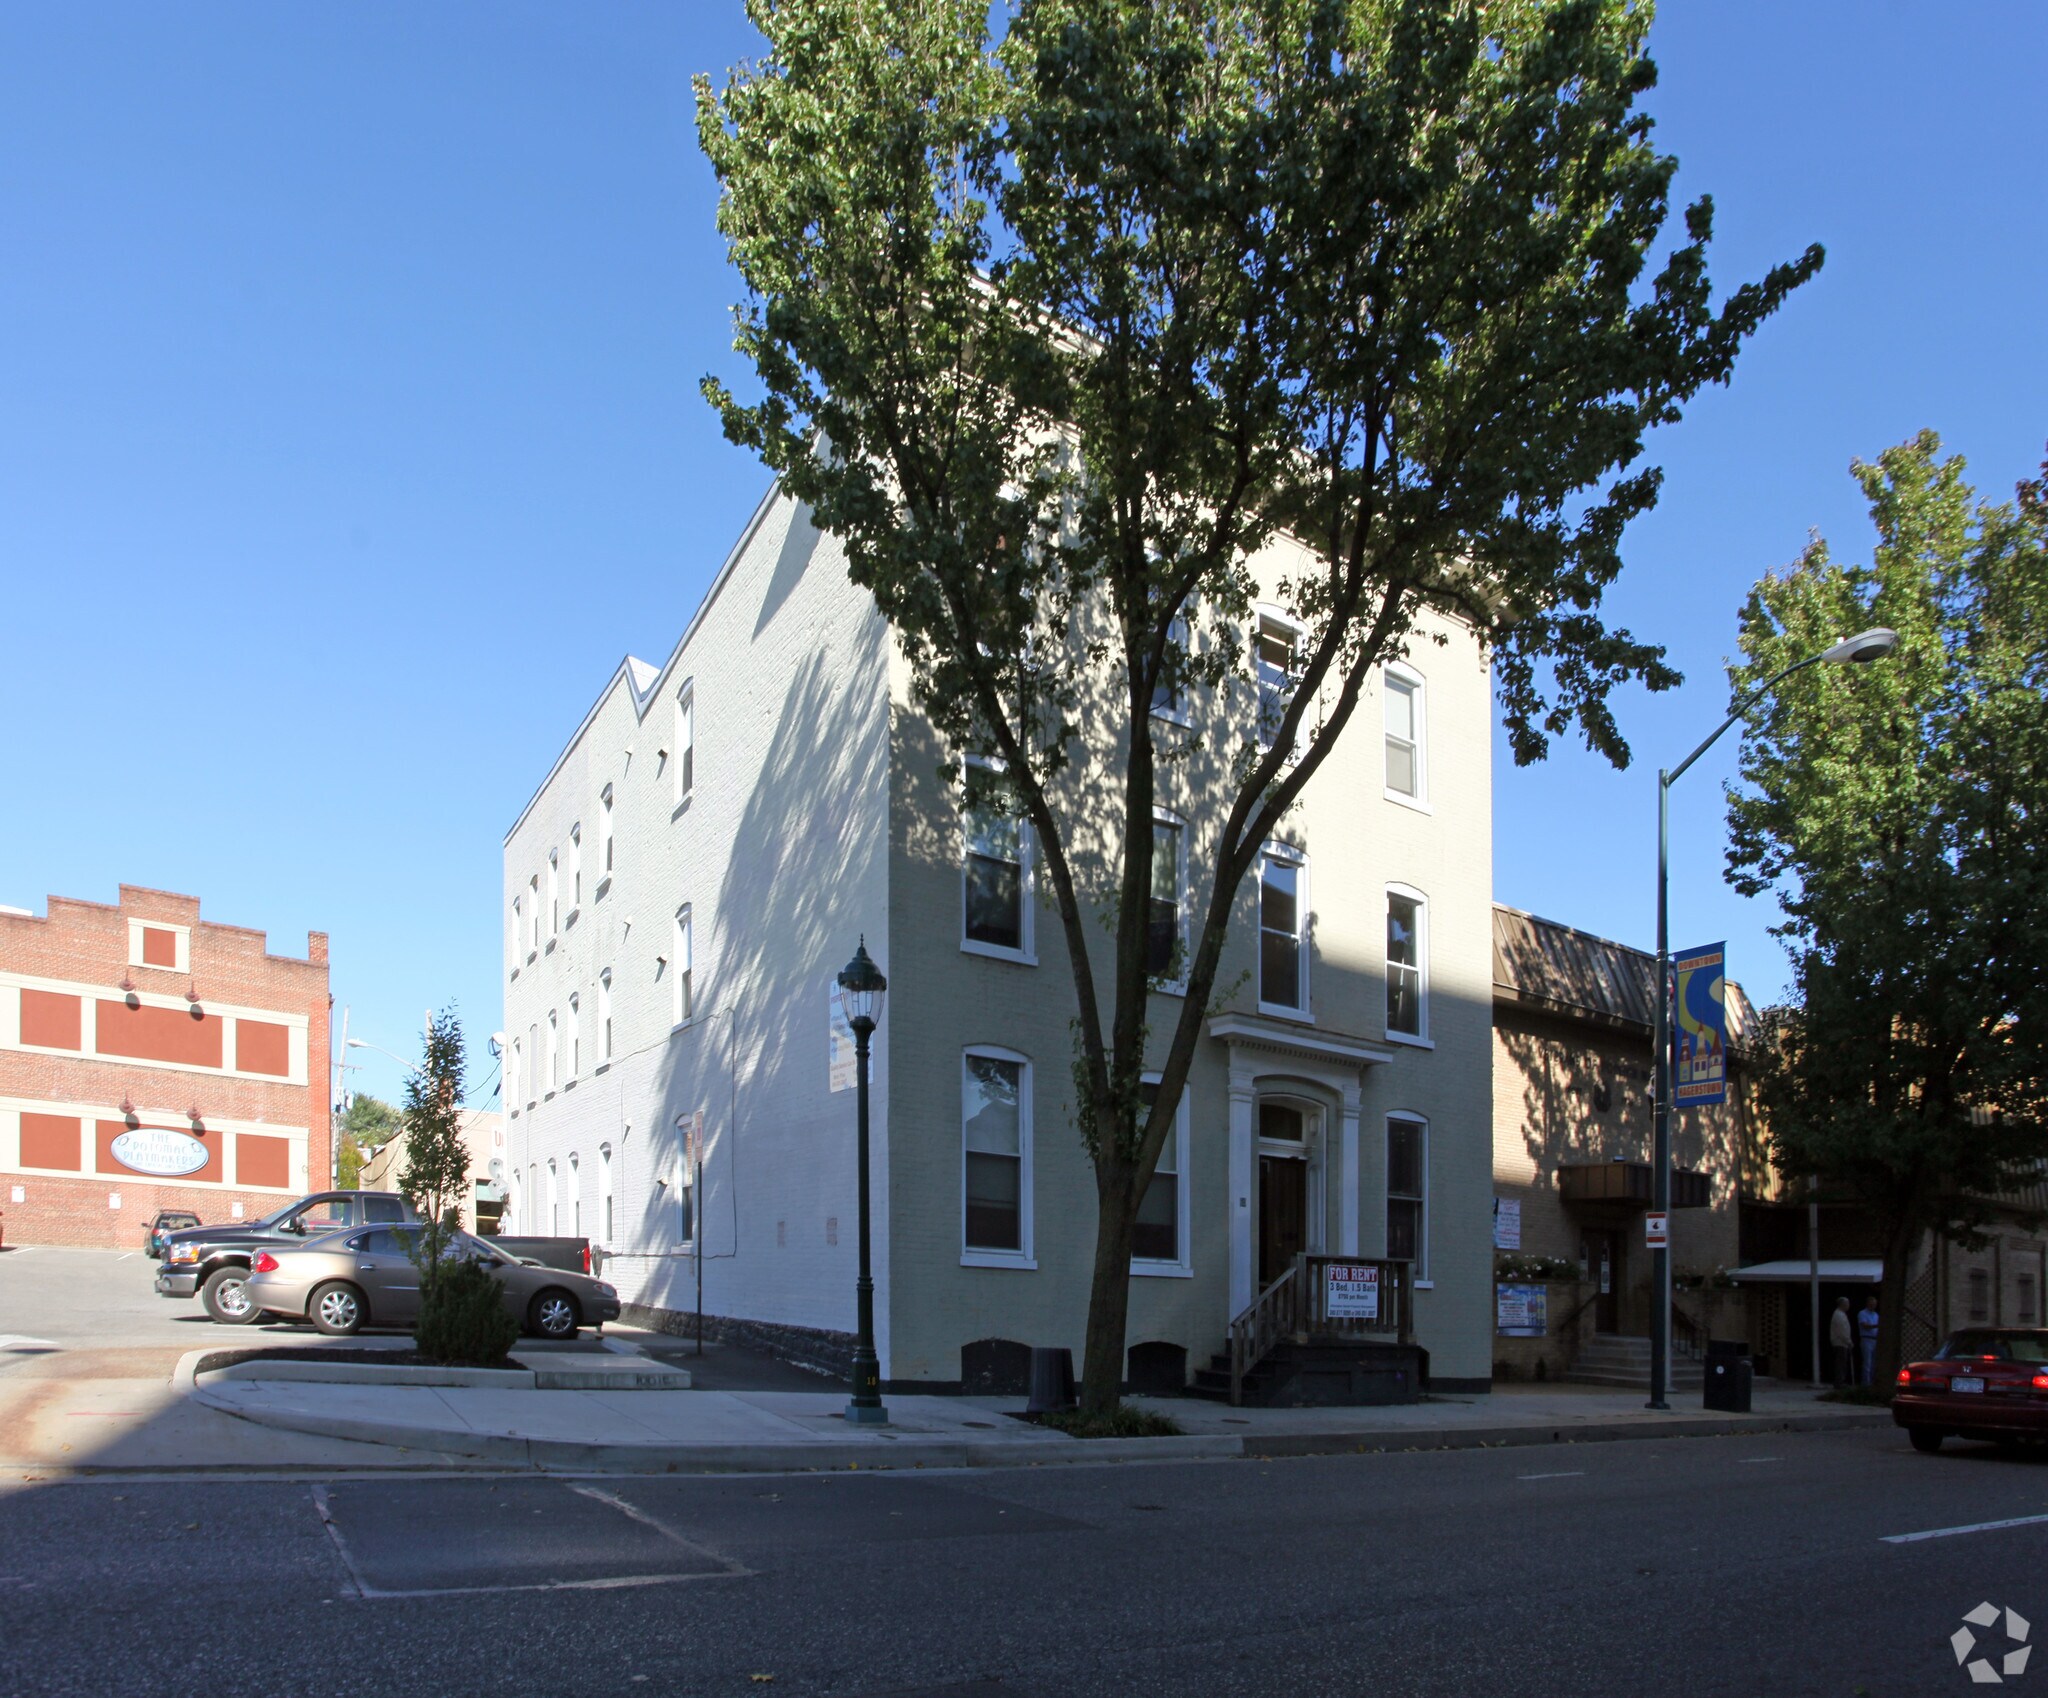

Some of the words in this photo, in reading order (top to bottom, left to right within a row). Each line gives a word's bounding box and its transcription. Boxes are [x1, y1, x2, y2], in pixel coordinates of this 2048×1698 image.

[151, 1133, 169, 1144] THE
[133, 1141, 188, 1155] POTOMAC
[123, 1151, 196, 1166] PLAYMAKERS
[1330, 1267, 1349, 1280] FOR
[1351, 1268, 1377, 1281] RENT
[1363, 1284, 1377, 1292] Bath
